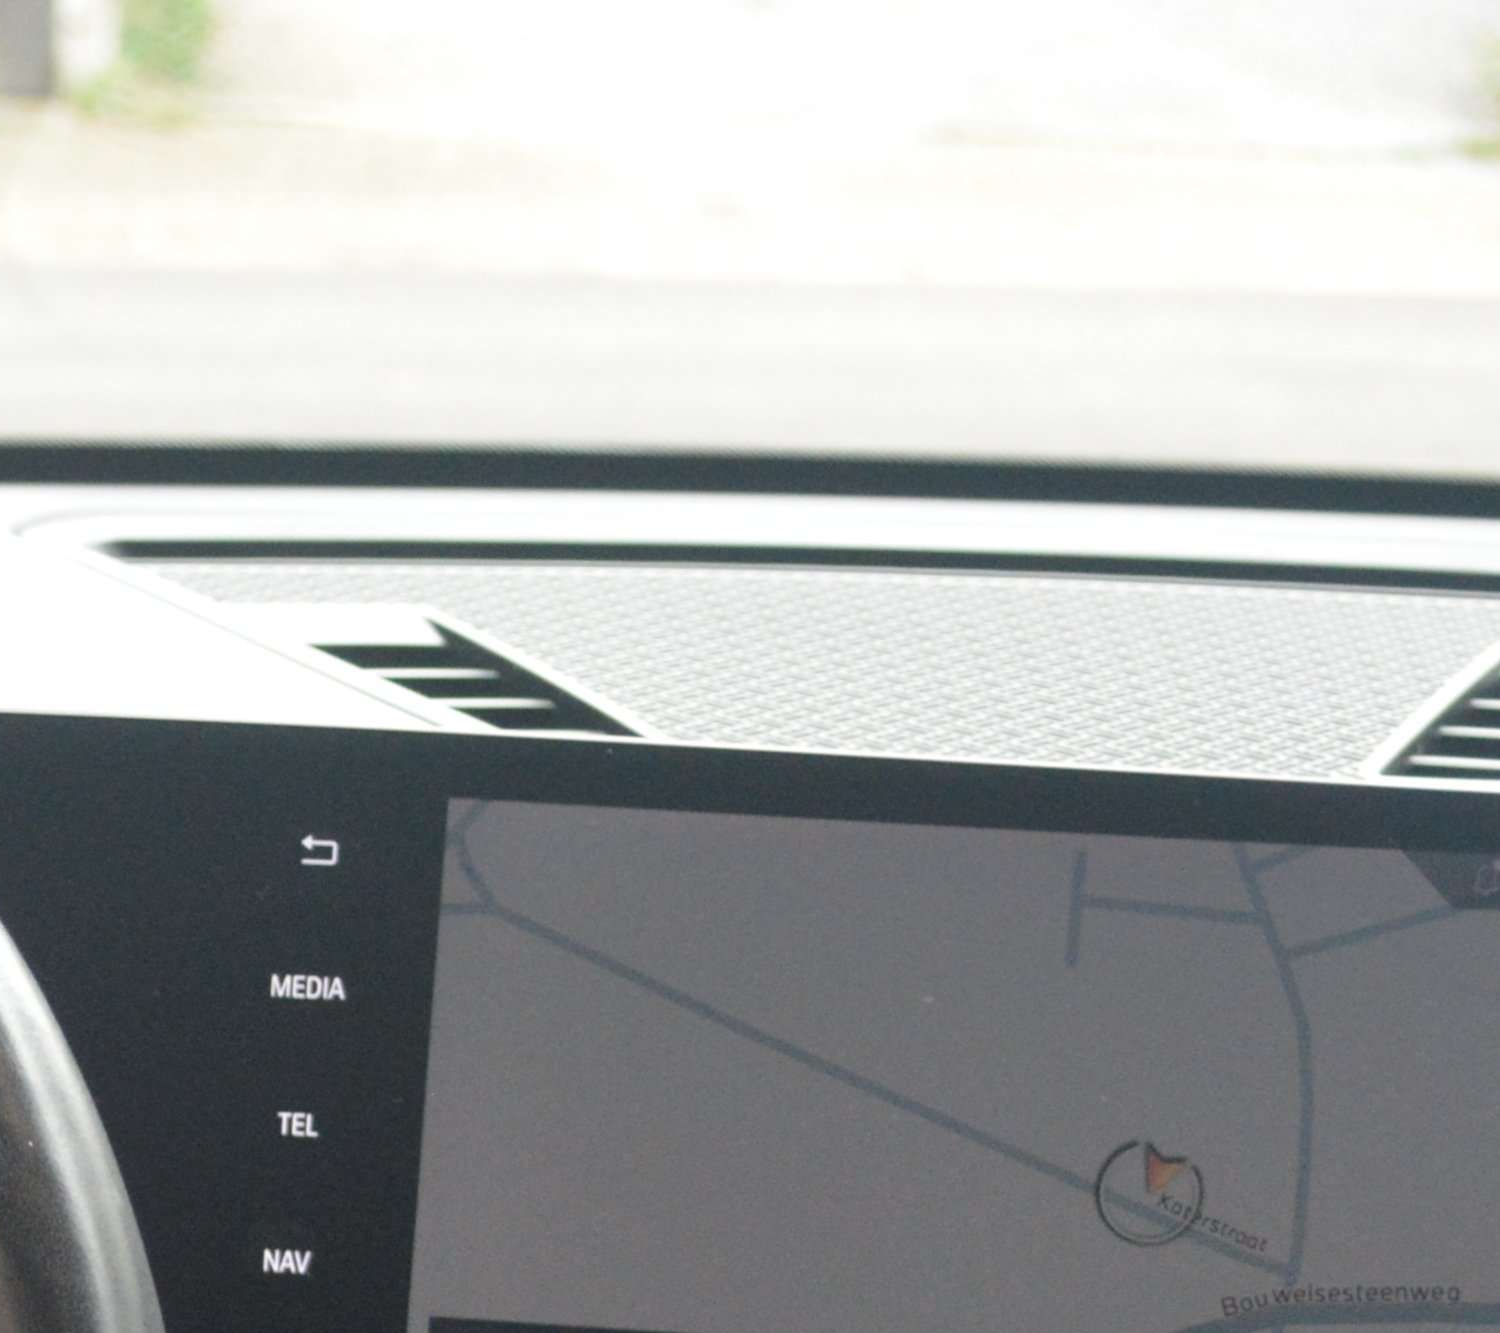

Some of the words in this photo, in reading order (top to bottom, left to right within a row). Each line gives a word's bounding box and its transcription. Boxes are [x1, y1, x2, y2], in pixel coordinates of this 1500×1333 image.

[270, 973, 346, 1001] MEDIA
[277, 1110, 319, 1138] TEL
[262, 1247, 312, 1275] NAV
